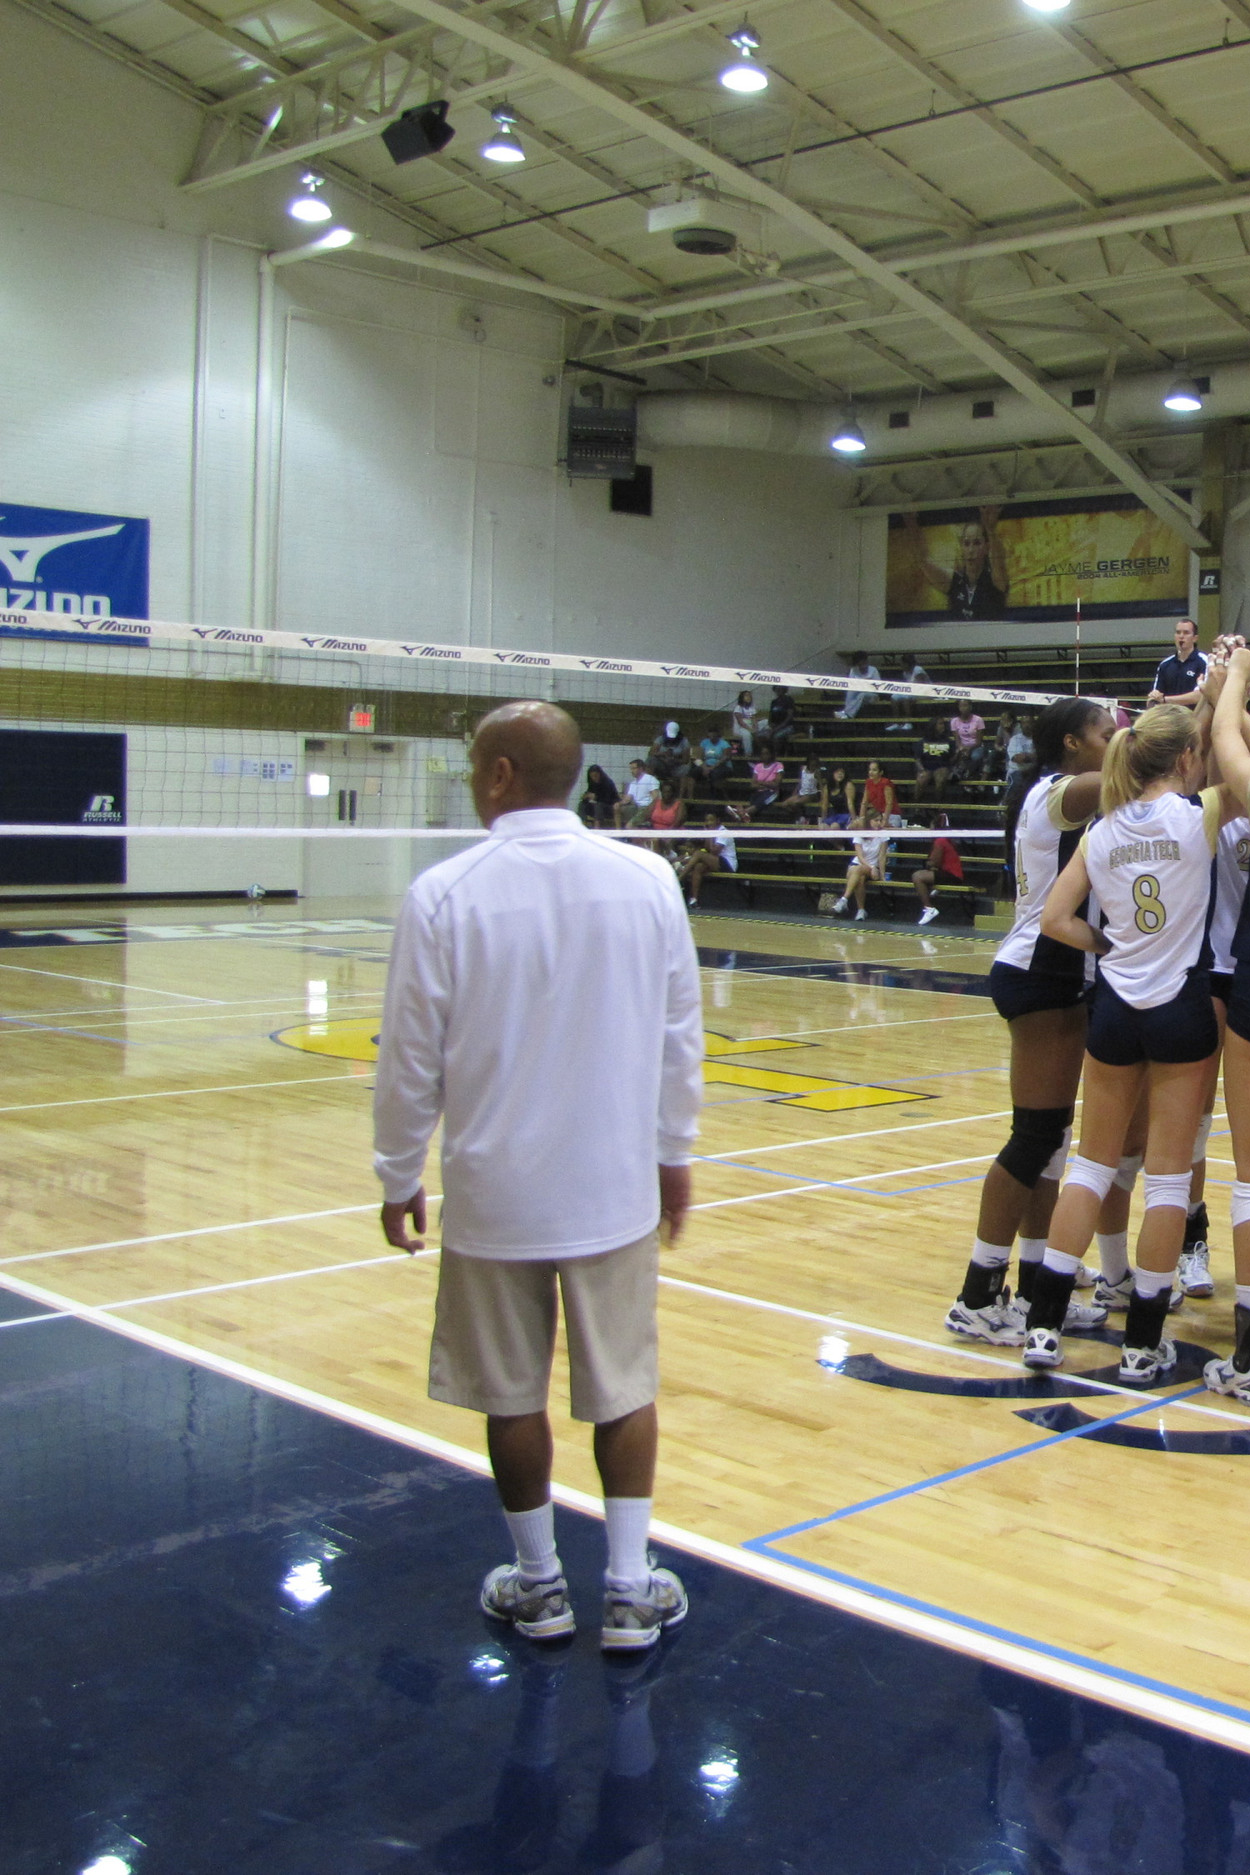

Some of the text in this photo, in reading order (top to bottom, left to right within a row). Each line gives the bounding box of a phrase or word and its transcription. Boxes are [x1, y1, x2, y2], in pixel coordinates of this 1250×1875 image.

[1043, 556, 1170, 575] JAYME GERGEN
[1109, 840, 1181, 870] GEORGIA TECH
[1132, 874, 1167, 935] 8
